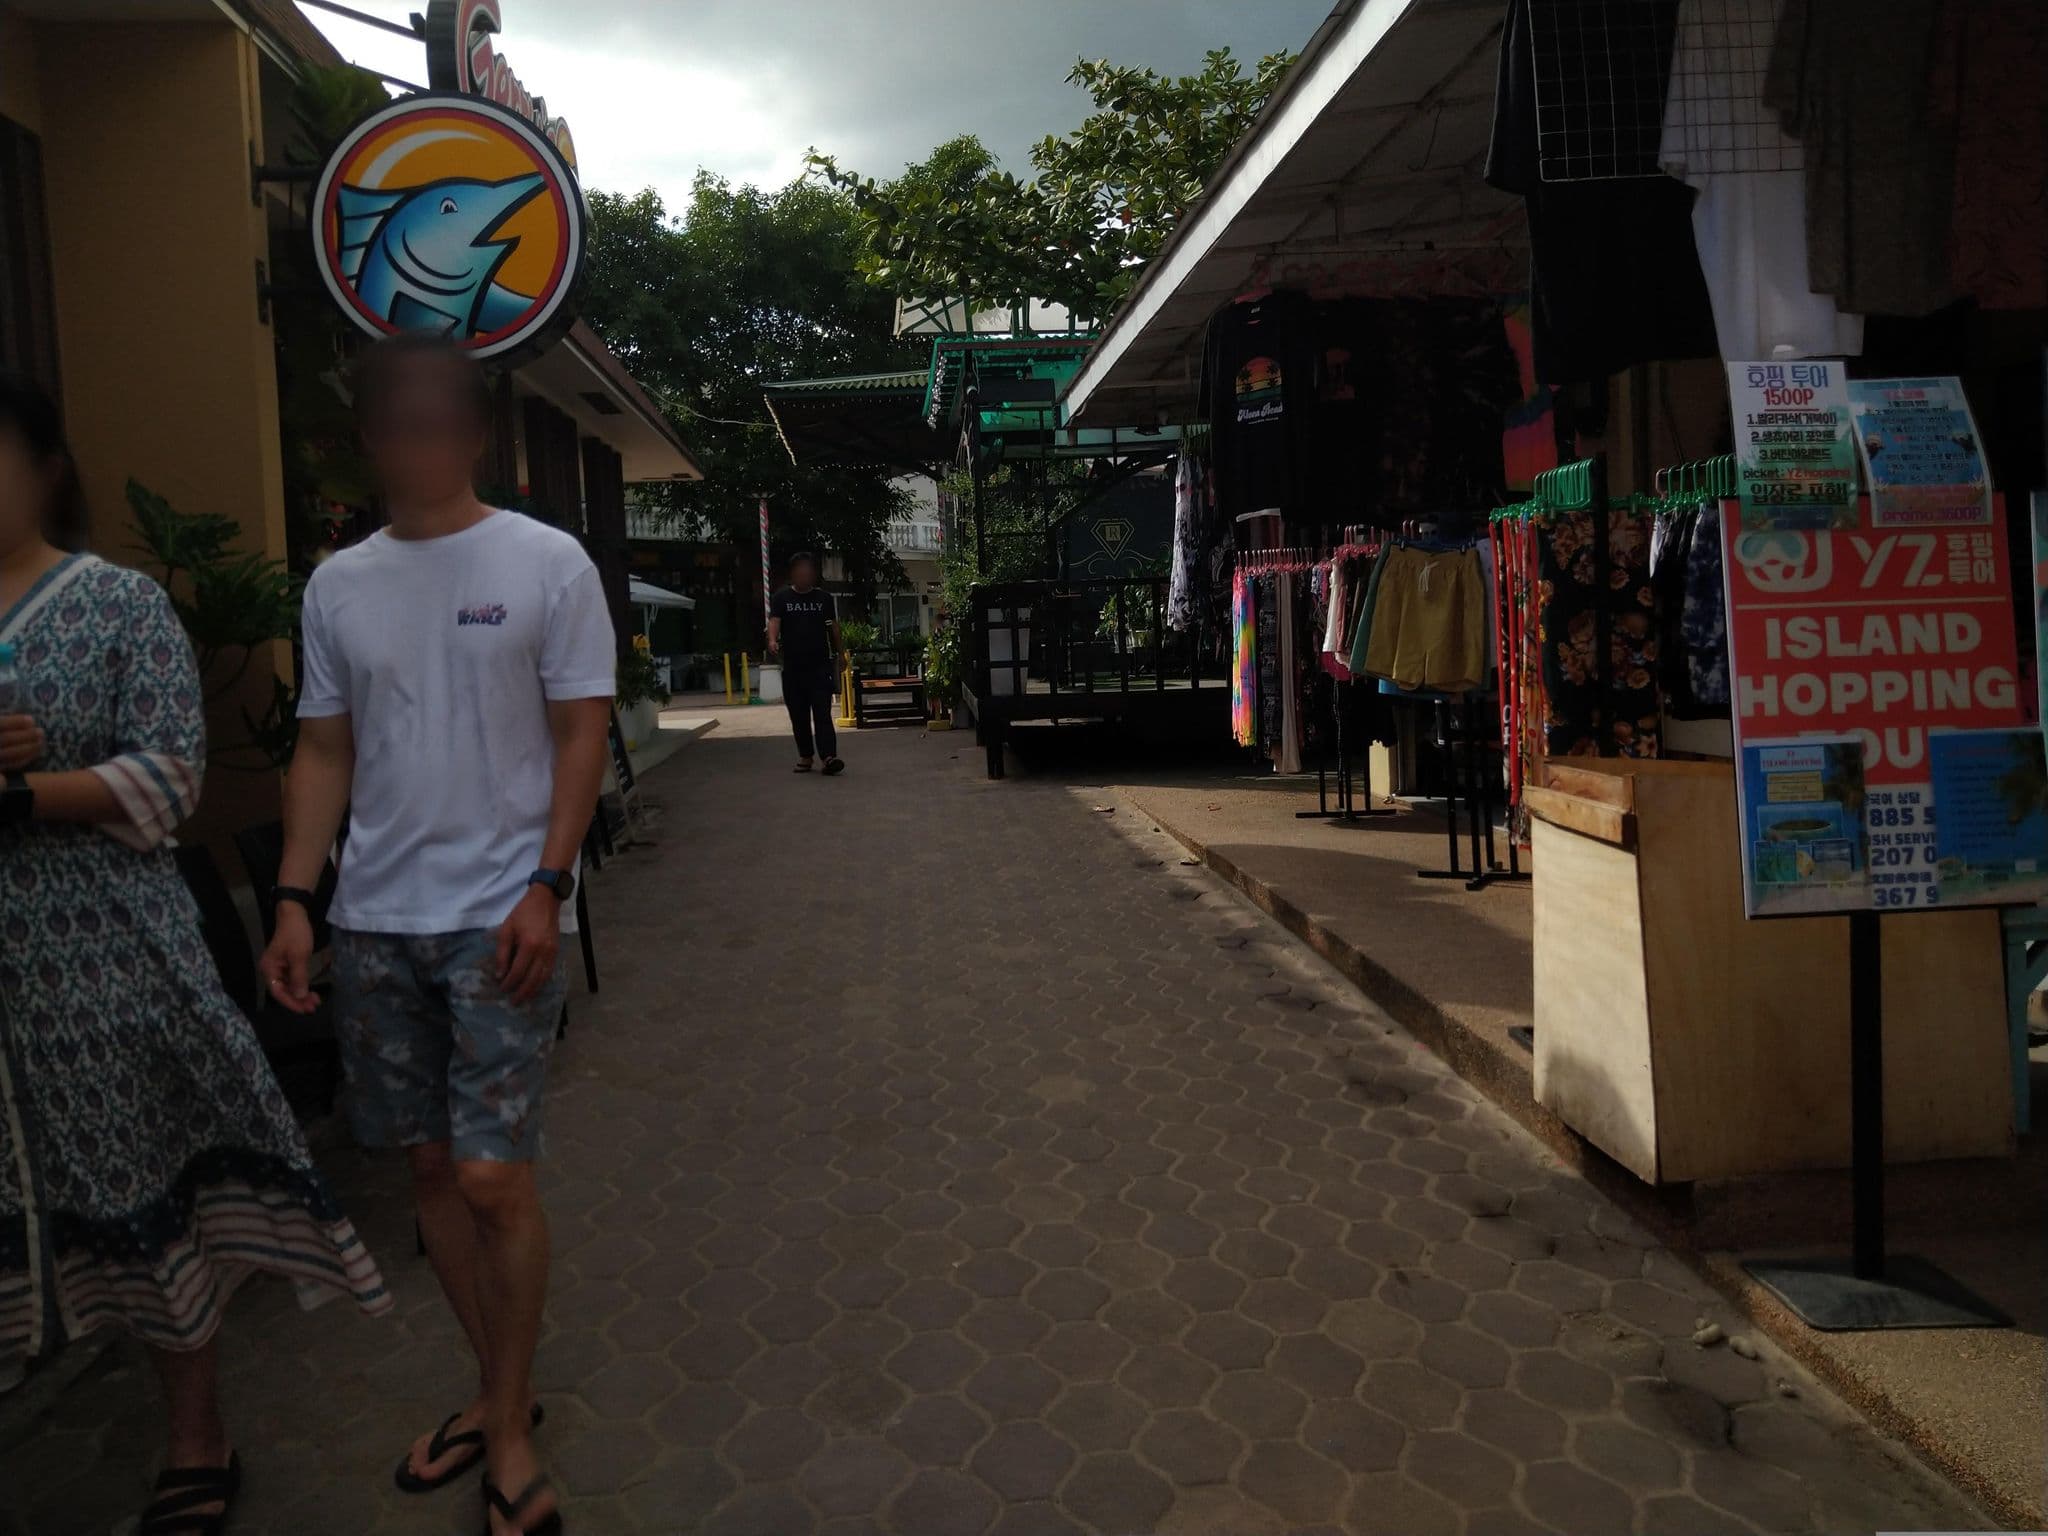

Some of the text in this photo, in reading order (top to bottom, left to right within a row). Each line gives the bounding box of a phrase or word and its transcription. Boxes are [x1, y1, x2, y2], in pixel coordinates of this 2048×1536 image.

[1747, 365, 1829, 389] 호핑 투어
[1763, 389, 1814, 405] 1500P
[1850, 534, 1945, 589] YZ
[786, 602, 823, 612] BALLY
[1765, 612, 1982, 660] ISLAND
[1738, 666, 2017, 718] HOPPING
[1870, 807, 1914, 827] 885
[1871, 847, 1914, 866] 207
[1874, 887, 1916, 907] 367
